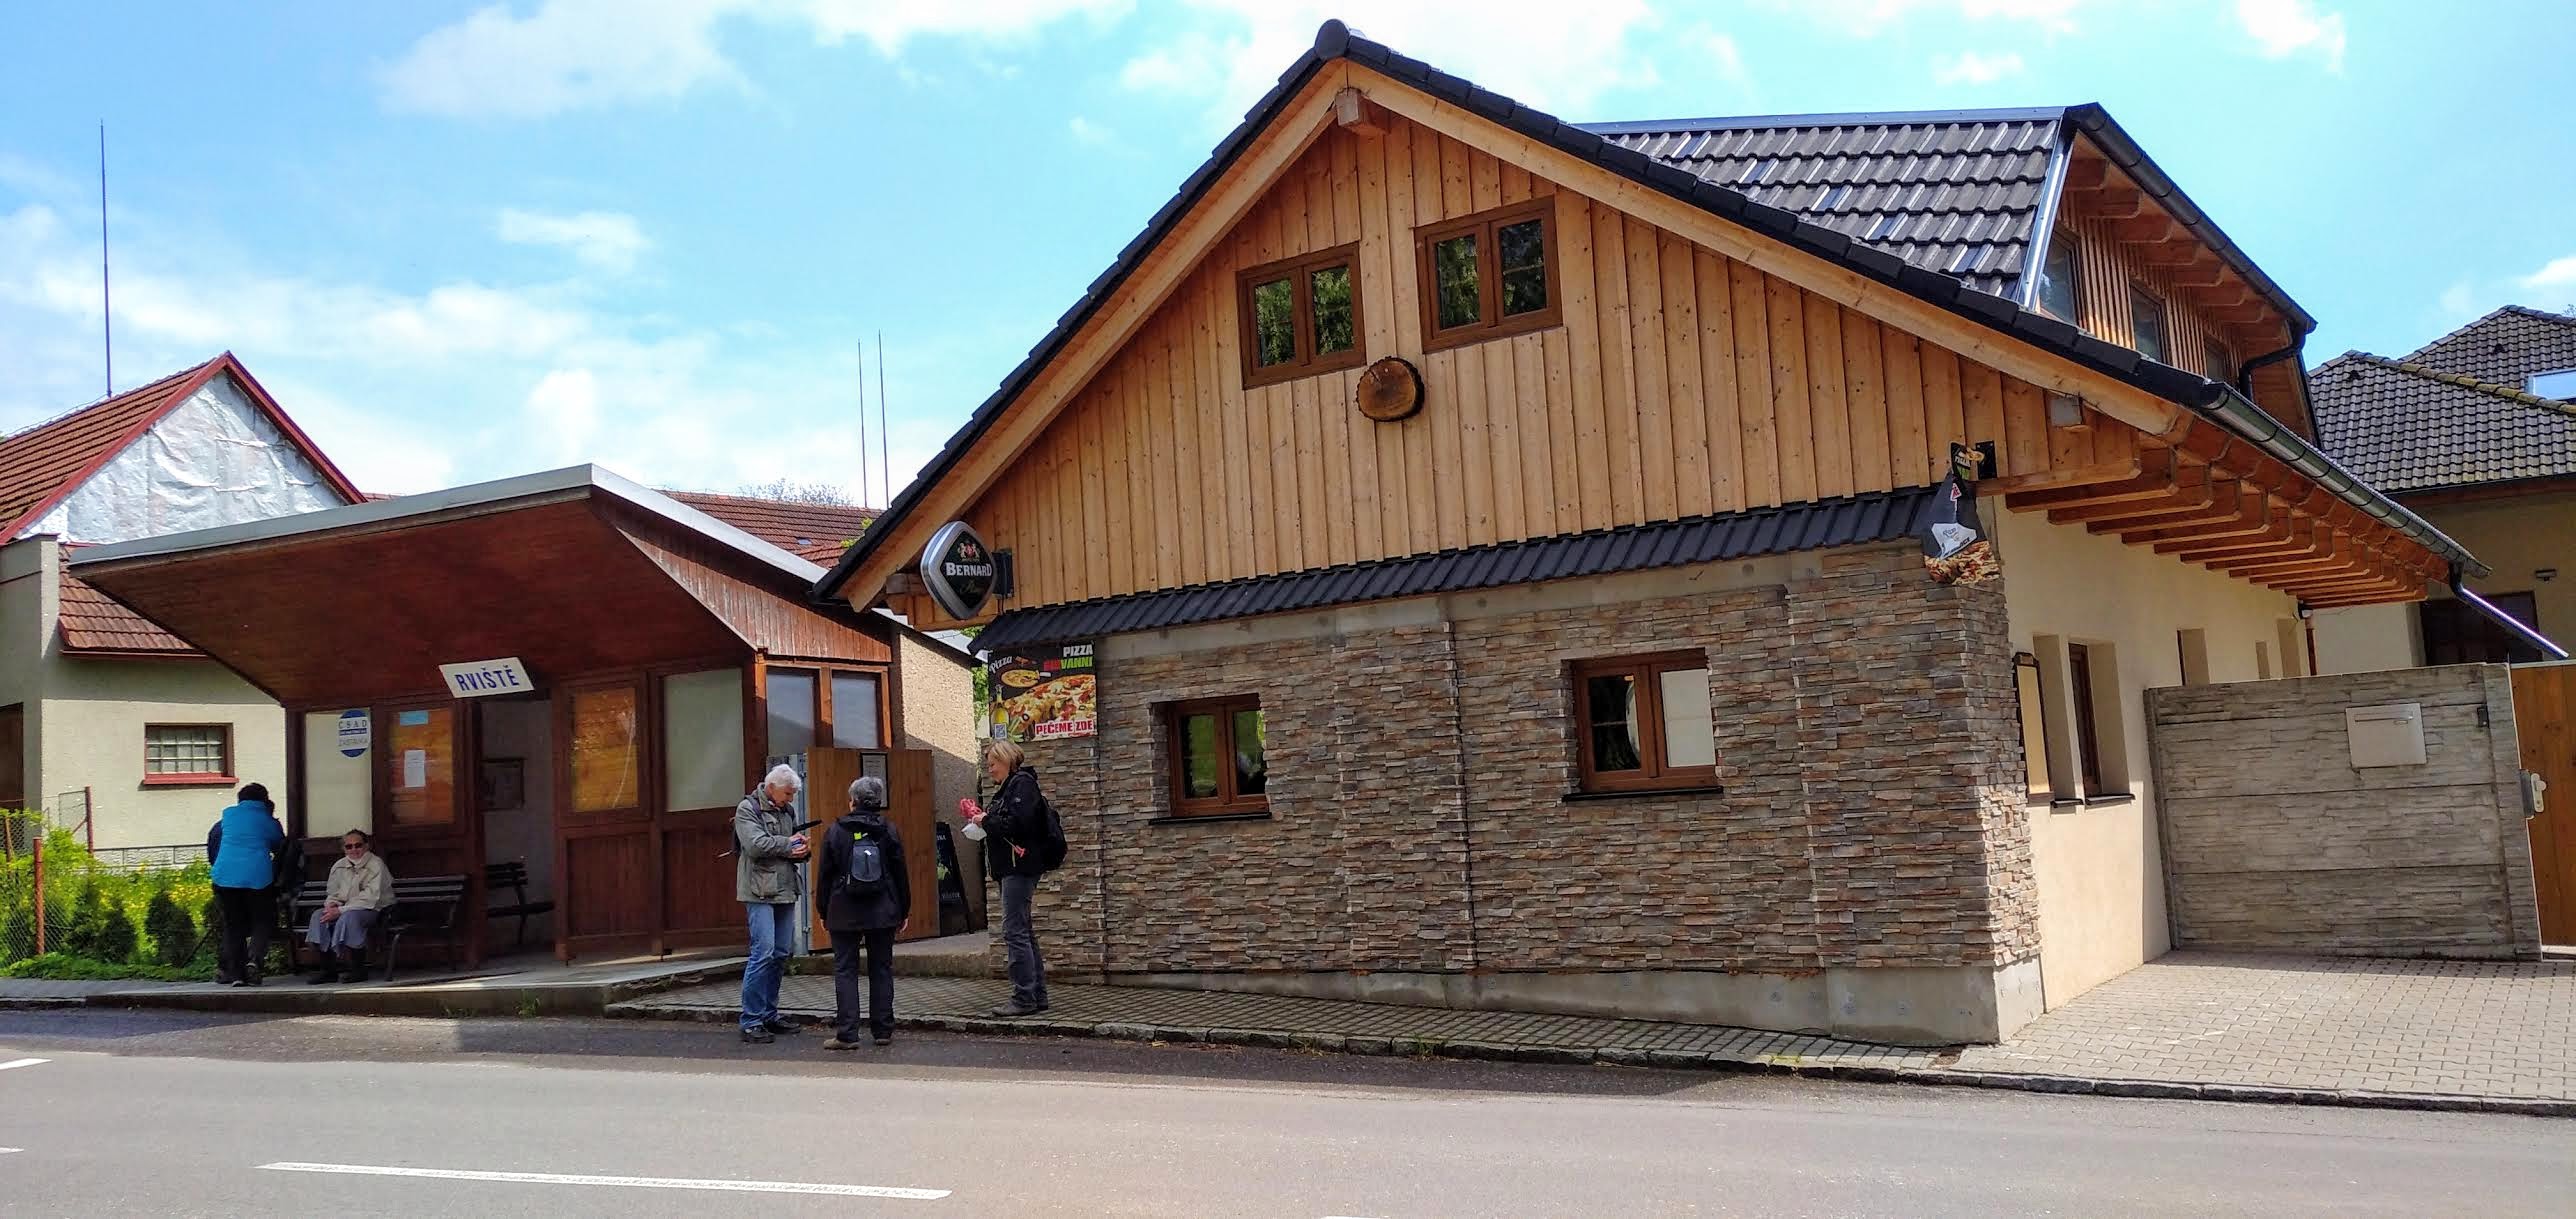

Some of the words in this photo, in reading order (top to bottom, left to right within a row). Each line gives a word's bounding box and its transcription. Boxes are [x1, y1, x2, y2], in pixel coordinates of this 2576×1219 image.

[945, 562, 992, 576] BERNARD
[1063, 644, 1093, 657] PIZZA
[988, 656, 1012, 674] Pizza
[454, 664, 520, 691] RVIŠTĚ
[1036, 721, 1073, 735] PEČEME
[1075, 720, 1093, 731] ZDE
